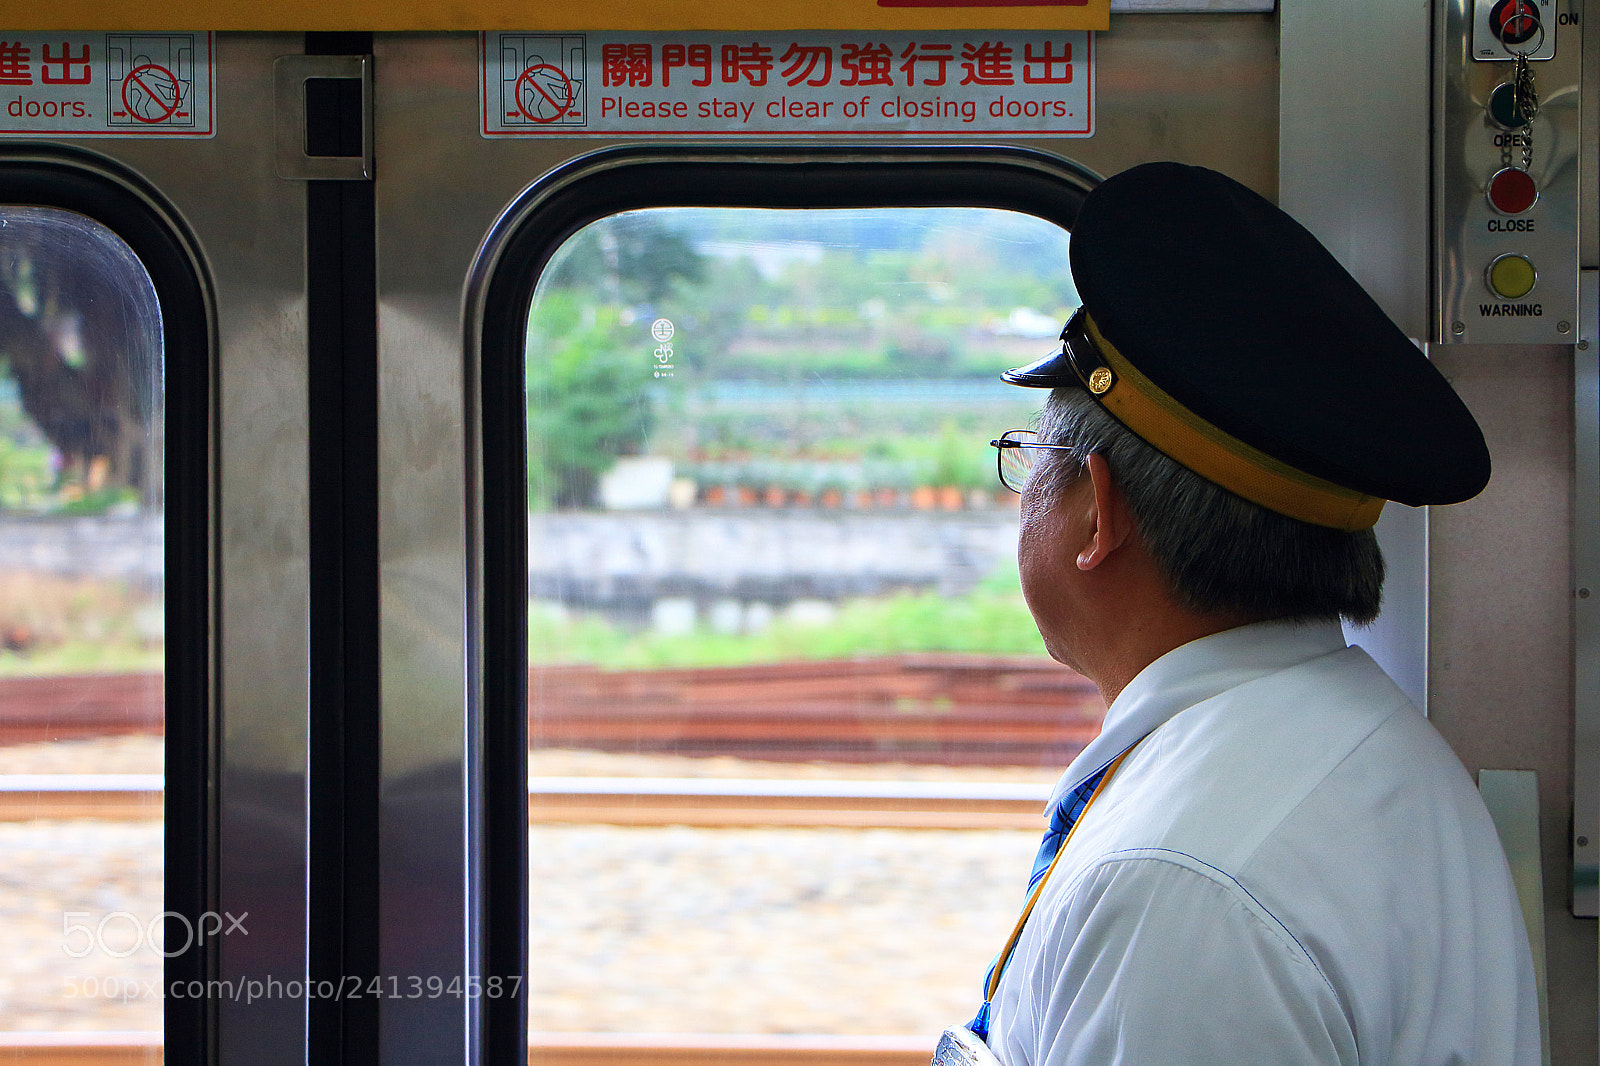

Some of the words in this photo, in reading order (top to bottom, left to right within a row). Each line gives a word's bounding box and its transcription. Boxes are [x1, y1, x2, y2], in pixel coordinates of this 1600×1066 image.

[1558, 13, 1578, 25] ON
[601, 41, 1073, 88] 關門時勿強行進出
[7, 96, 93, 118] doors.
[601, 96, 688, 118] Please
[698, 97, 755, 123] stay
[766, 96, 834, 118] clear
[843, 96, 870, 118] of
[881, 96, 976, 123] closing
[989, 96, 1074, 118] doors.
[1493, 134, 1533, 147] OPE
[1487, 219, 1535, 232] CLOSE
[1479, 304, 1543, 317] WARNING
